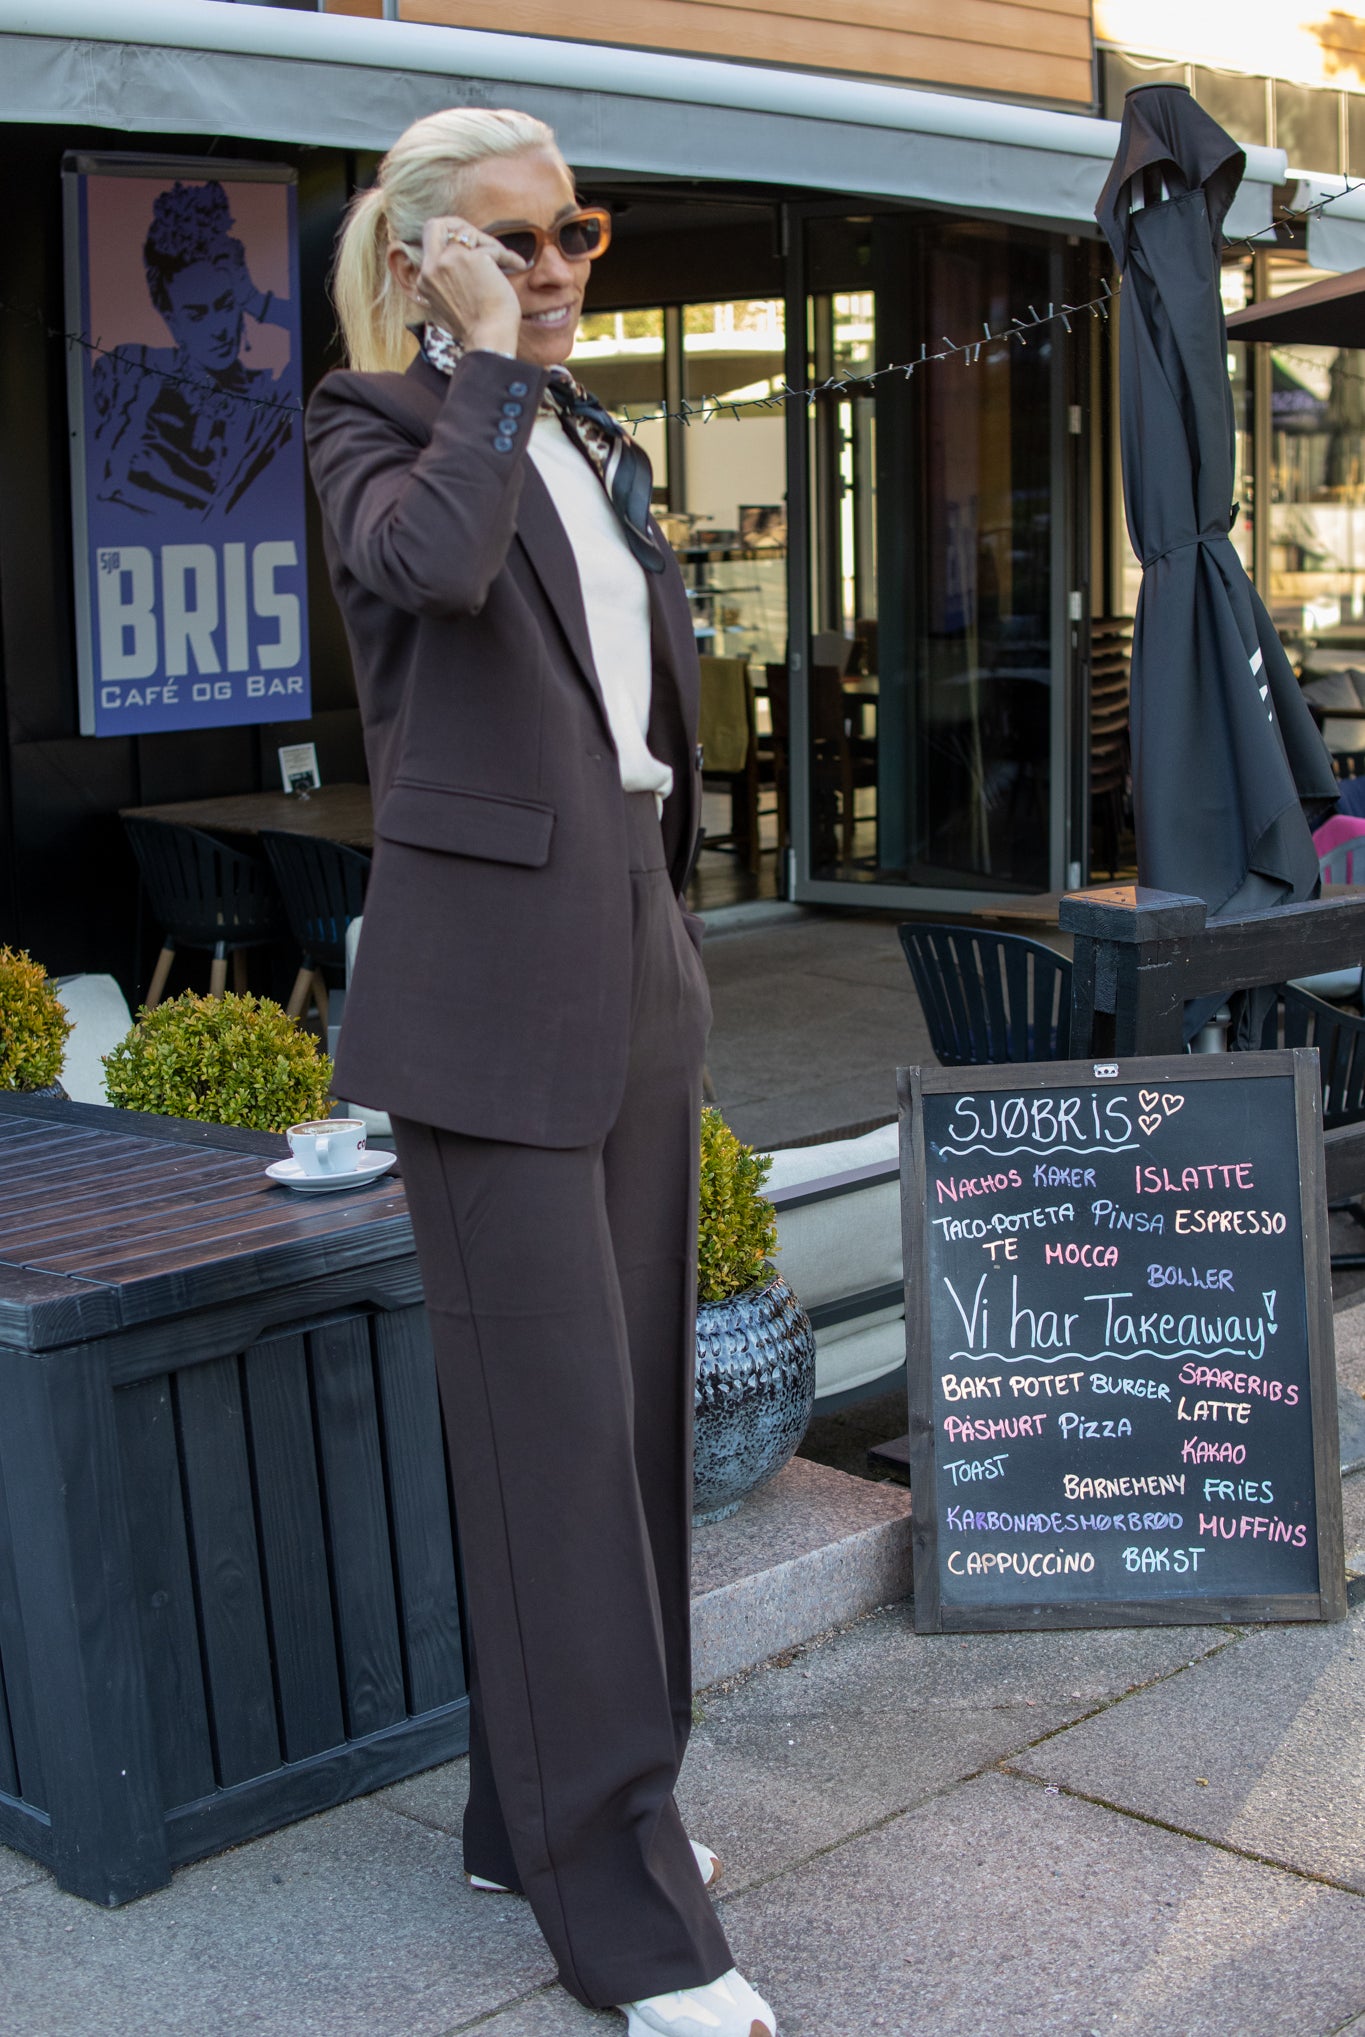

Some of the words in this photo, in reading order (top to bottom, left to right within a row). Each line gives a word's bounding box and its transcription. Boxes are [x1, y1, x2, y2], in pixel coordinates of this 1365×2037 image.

[97, 541, 301, 682] BRIS
[936, 1169, 1023, 1204] NACHOS
[1033, 1164, 1097, 1188] KAKER
[1135, 1163, 1255, 1194] ISLATTE
[932, 1203, 1075, 1241] TACO-POTETA
[1175, 1210, 1287, 1236] ESPRESSO
[982, 1238, 1019, 1261] TE
[1045, 1243, 1119, 1268] MOCCA
[1147, 1264, 1235, 1292] BOLLER
[944, 1273, 988, 1349] Vi
[1010, 1275, 1080, 1349] har
[941, 1374, 1002, 1401] BAKT
[1009, 1372, 1085, 1398] POTET
[1089, 1373, 1172, 1403] BURGER
[1178, 1362, 1300, 1406] SPARERIBS
[1177, 1397, 1251, 1424] LATTE
[1181, 1436, 1247, 1465] KAKAO
[943, 1454, 1009, 1486] TOAST
[1063, 1474, 1186, 1500] BARNEMENY
[1121, 1546, 1206, 1573] BAKST
